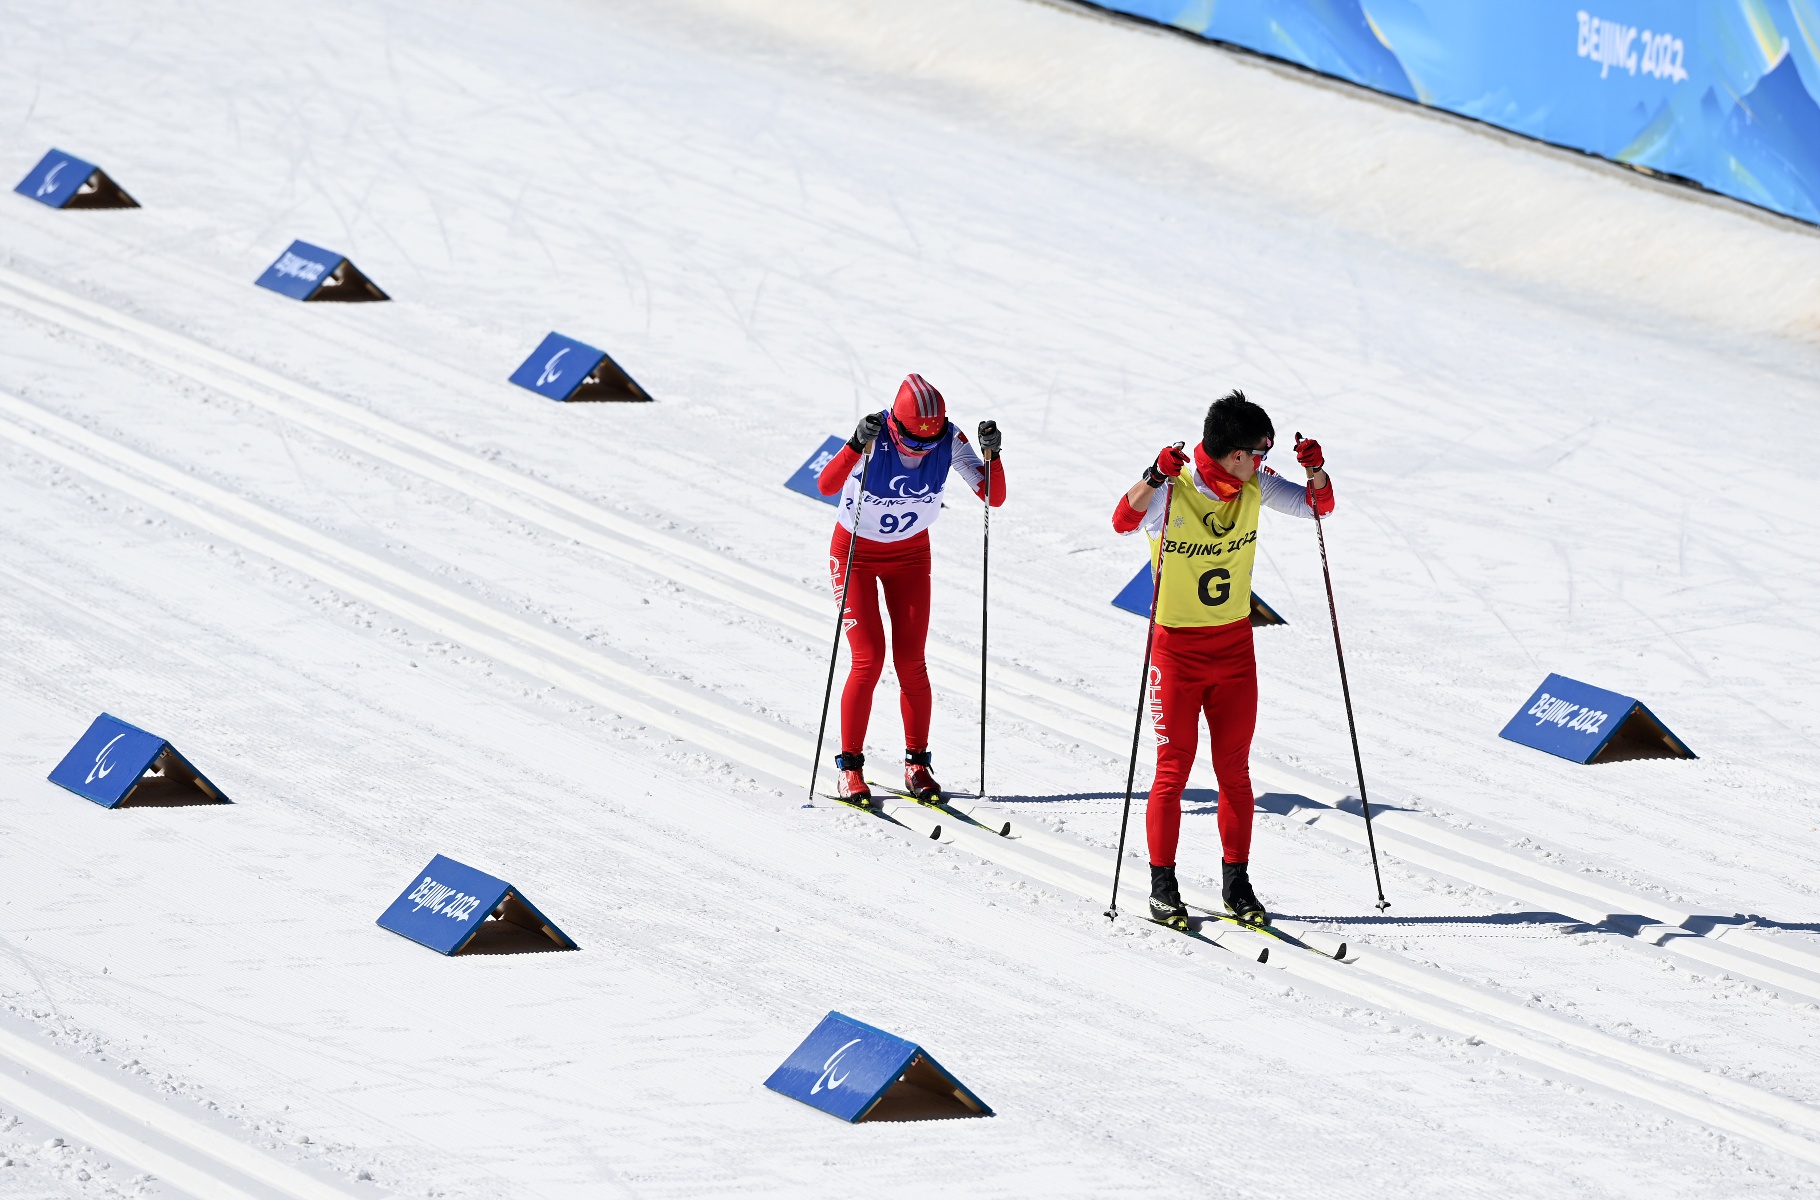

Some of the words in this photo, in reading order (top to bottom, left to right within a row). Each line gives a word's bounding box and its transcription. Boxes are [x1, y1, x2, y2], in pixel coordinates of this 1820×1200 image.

[1576, 10, 1638, 79] BEIJING
[1641, 29, 1689, 84] 2022
[878, 511, 919, 534] 92
[1164, 540, 1223, 558] BEIJING
[1197, 567, 1231, 606] G
[1149, 665, 1170, 747] CHINA
[1527, 693, 1580, 728] BEIJING
[1567, 708, 1609, 734] 2022
[407, 876, 457, 914] BEIJING
[440, 892, 481, 922] 2022
